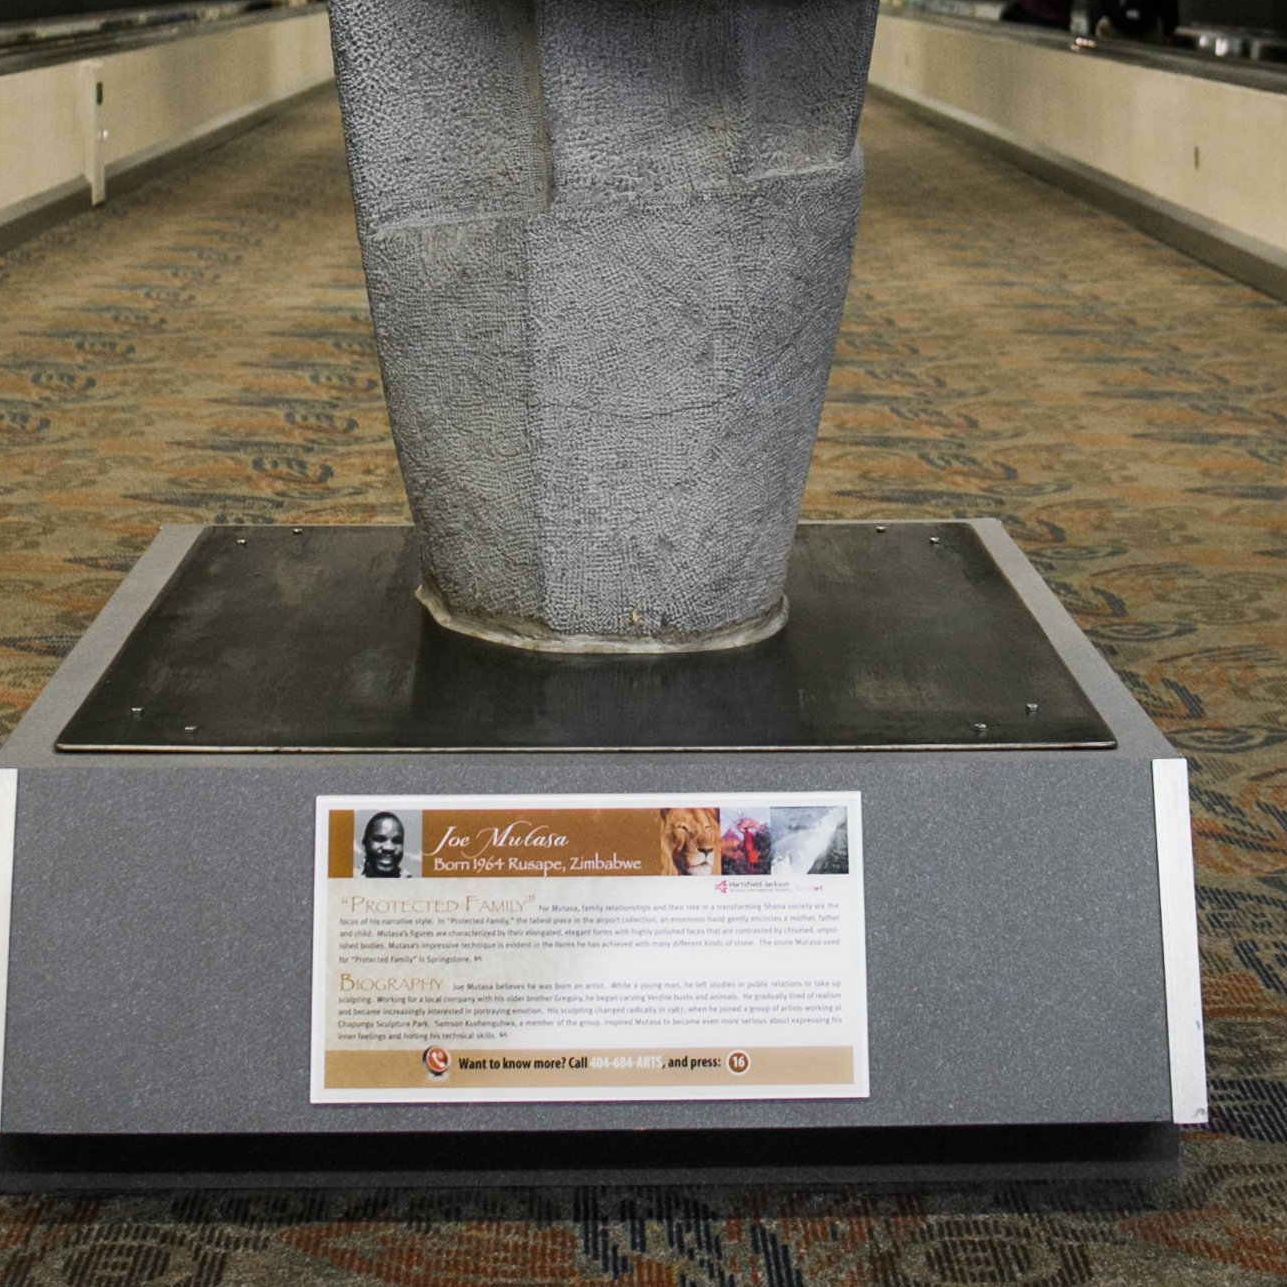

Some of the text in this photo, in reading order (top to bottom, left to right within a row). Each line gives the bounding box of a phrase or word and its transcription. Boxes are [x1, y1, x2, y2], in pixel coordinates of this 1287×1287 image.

[422, 820, 569, 858] Joe Mutasa
[434, 852, 642, 877] Born 1964 Rusape, Zimbabwe
[581, 904, 604, 914] family
[605, 904, 651, 913] relationships
[716, 903, 762, 912] transforming
[788, 902, 813, 912] society
[553, 916, 572, 926] piece
[596, 916, 620, 925] airport
[727, 915, 749, 924] gently
[409, 929, 434, 939] figures
[564, 928, 591, 938] elegant
[631, 928, 653, 937] highly
[654, 927, 685, 937] polished
[421, 941, 459, 951] impressive
[461, 941, 496, 950] technique
[340, 973, 444, 991] BIOGRAPHY
[453, 983, 465, 991] Joe
[747, 980, 769, 990] public
[376, 996, 406, 1005] Working
[596, 994, 618, 1003] began
[619, 993, 646, 1003] carving
[754, 992, 787, 1002] gradually
[383, 1008, 426, 1017] increasingly
[473, 1007, 511, 1016] portraying
[560, 1006, 593, 1016] sculpting
[595, 1006, 625, 1016] changed
[626, 1006, 657, 1015] radically
[667, 1006, 687, 1015] 1987,
[719, 1005, 742, 1015] joined
[805, 1004, 834, 1014] working
[338, 1020, 375, 1030] Chapungu
[376, 1020, 411, 1030] Sculpture
[604, 1018, 633, 1028] inspired
[791, 1017, 830, 1026] expressing
[358, 1032, 386, 1042] feelings
[403, 1032, 428, 1042] honing
[459, 1056, 745, 1070] Want to know more? Call 404-684-ARTS, and press: 16
